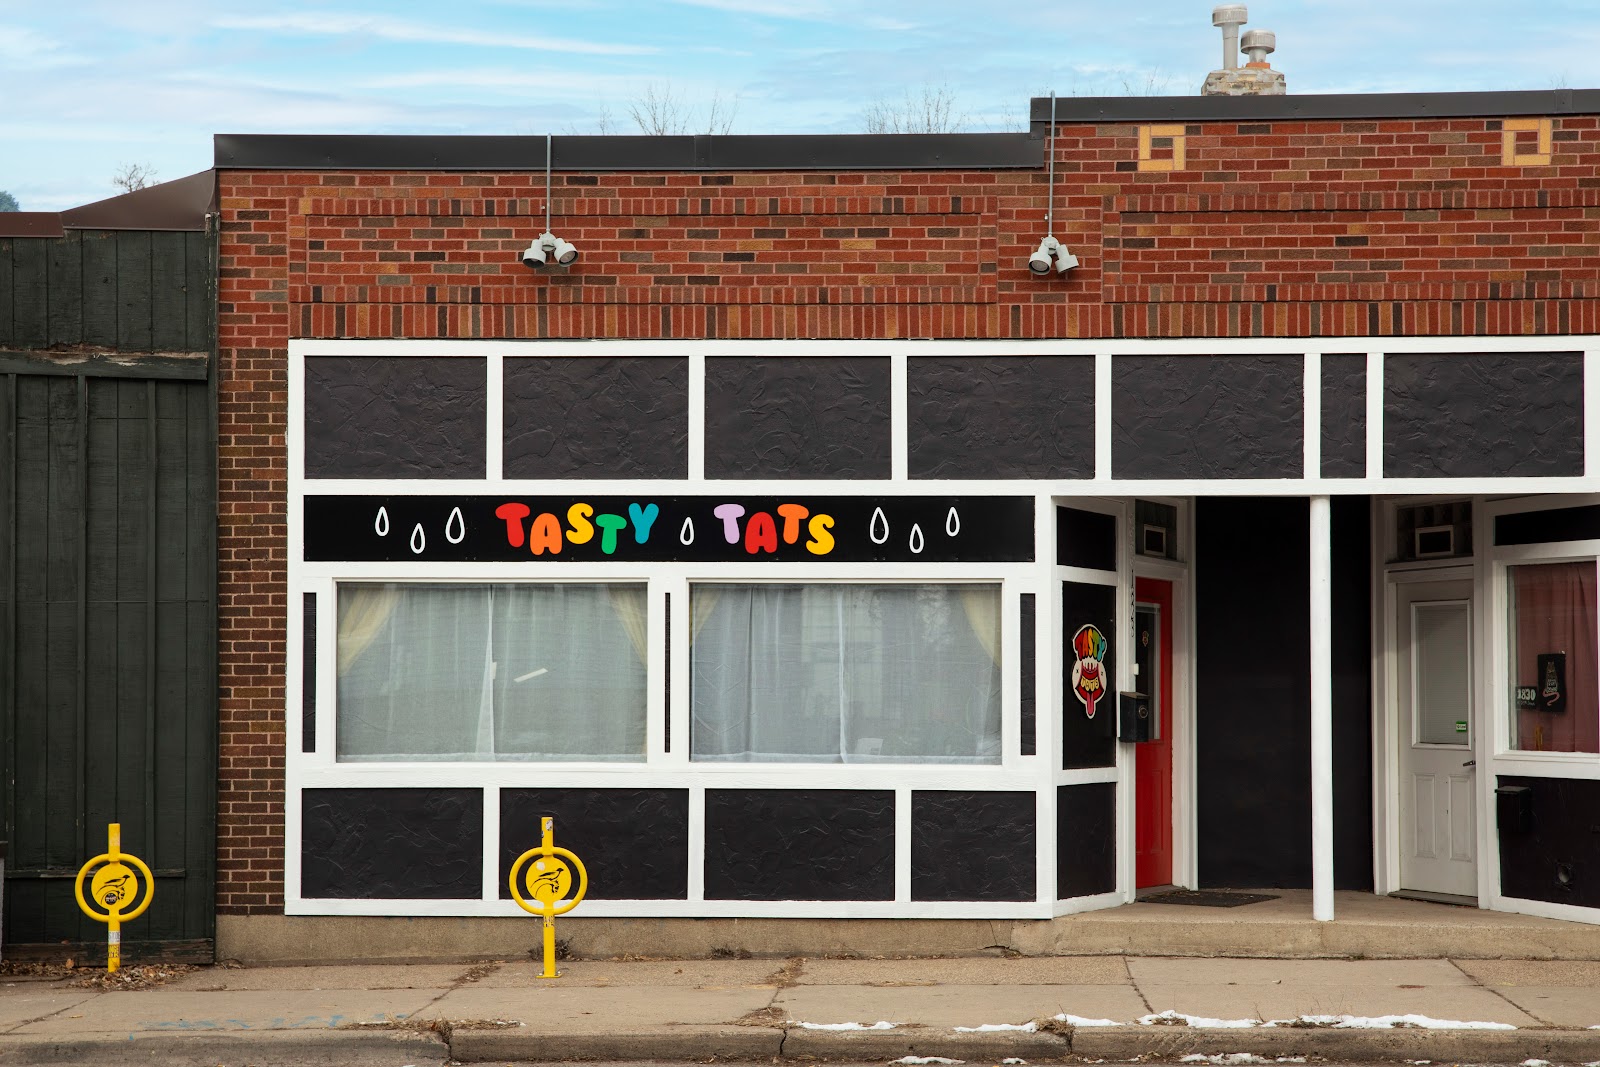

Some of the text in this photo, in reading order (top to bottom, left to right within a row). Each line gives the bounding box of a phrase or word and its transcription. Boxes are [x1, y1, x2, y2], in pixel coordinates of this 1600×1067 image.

[495, 502, 835, 555] TASTY TATS
[1075, 627, 1105, 661] TASTY
[1517, 688, 1536, 700] 1830
